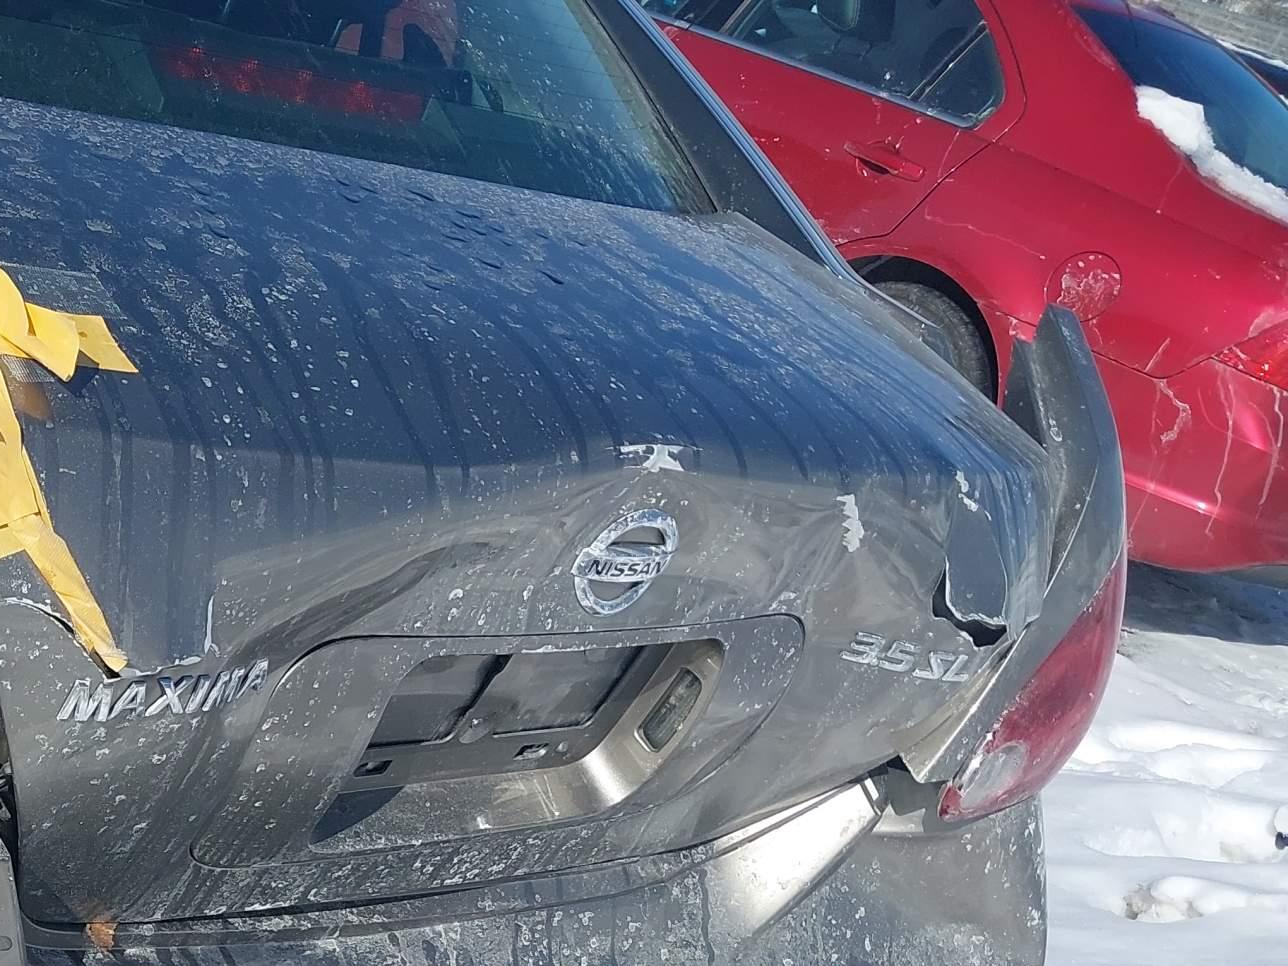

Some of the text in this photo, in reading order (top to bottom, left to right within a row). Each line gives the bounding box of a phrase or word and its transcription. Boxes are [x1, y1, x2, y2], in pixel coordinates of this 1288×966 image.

[587, 559, 665, 578] NISSAN
[912, 651, 969, 682] SL
[56, 657, 269, 722] MAXIMA
